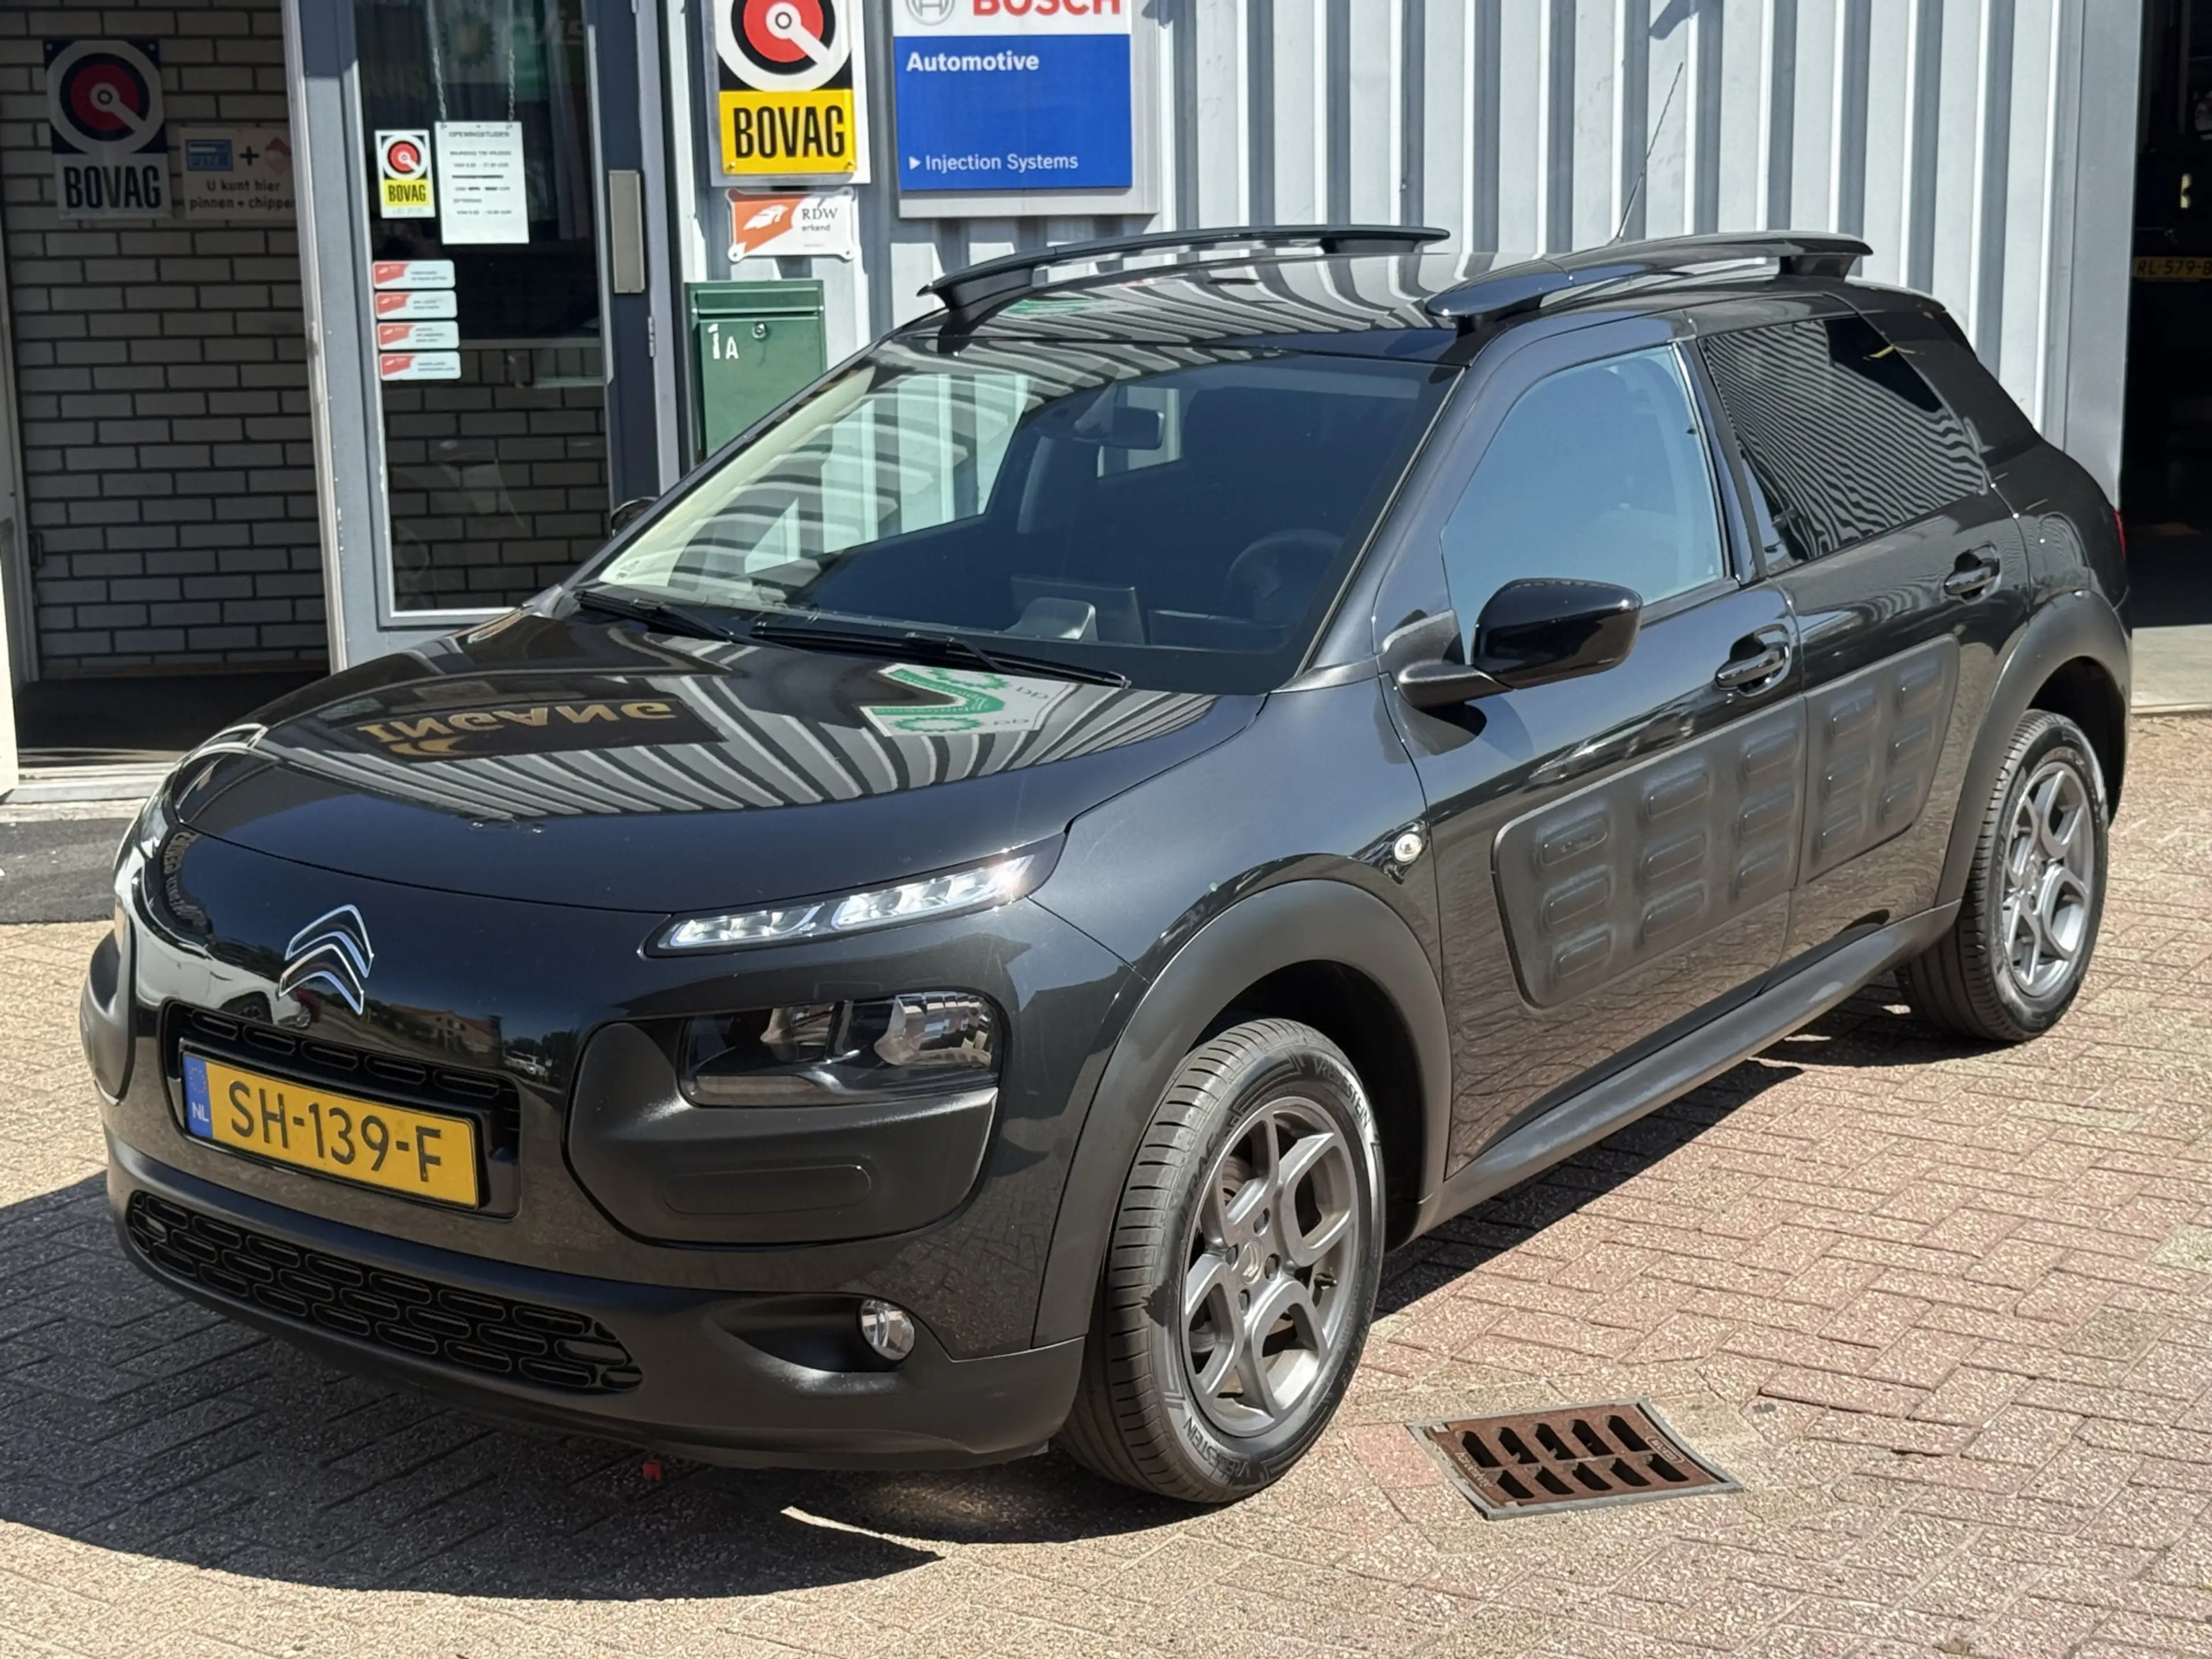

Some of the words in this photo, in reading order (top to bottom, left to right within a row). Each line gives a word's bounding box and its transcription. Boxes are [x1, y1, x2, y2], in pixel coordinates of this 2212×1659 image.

[906, 50, 1040, 71] Automotive
[733, 105, 845, 158] BOVAG
[925, 154, 1001, 174] Injection
[1007, 153, 1078, 173] Systems
[63, 165, 162, 209] BOVAG
[206, 180, 216, 192] U
[220, 179, 250, 191] kunt
[254, 179, 282, 191] hier
[388, 184, 427, 202] BOVAG
[190, 196, 234, 212] pinnen
[801, 208, 838, 220] RDW
[801, 224, 831, 232] erkend
[191, 1101, 210, 1123] NL
[228, 1080, 442, 1183] SH-139-F
